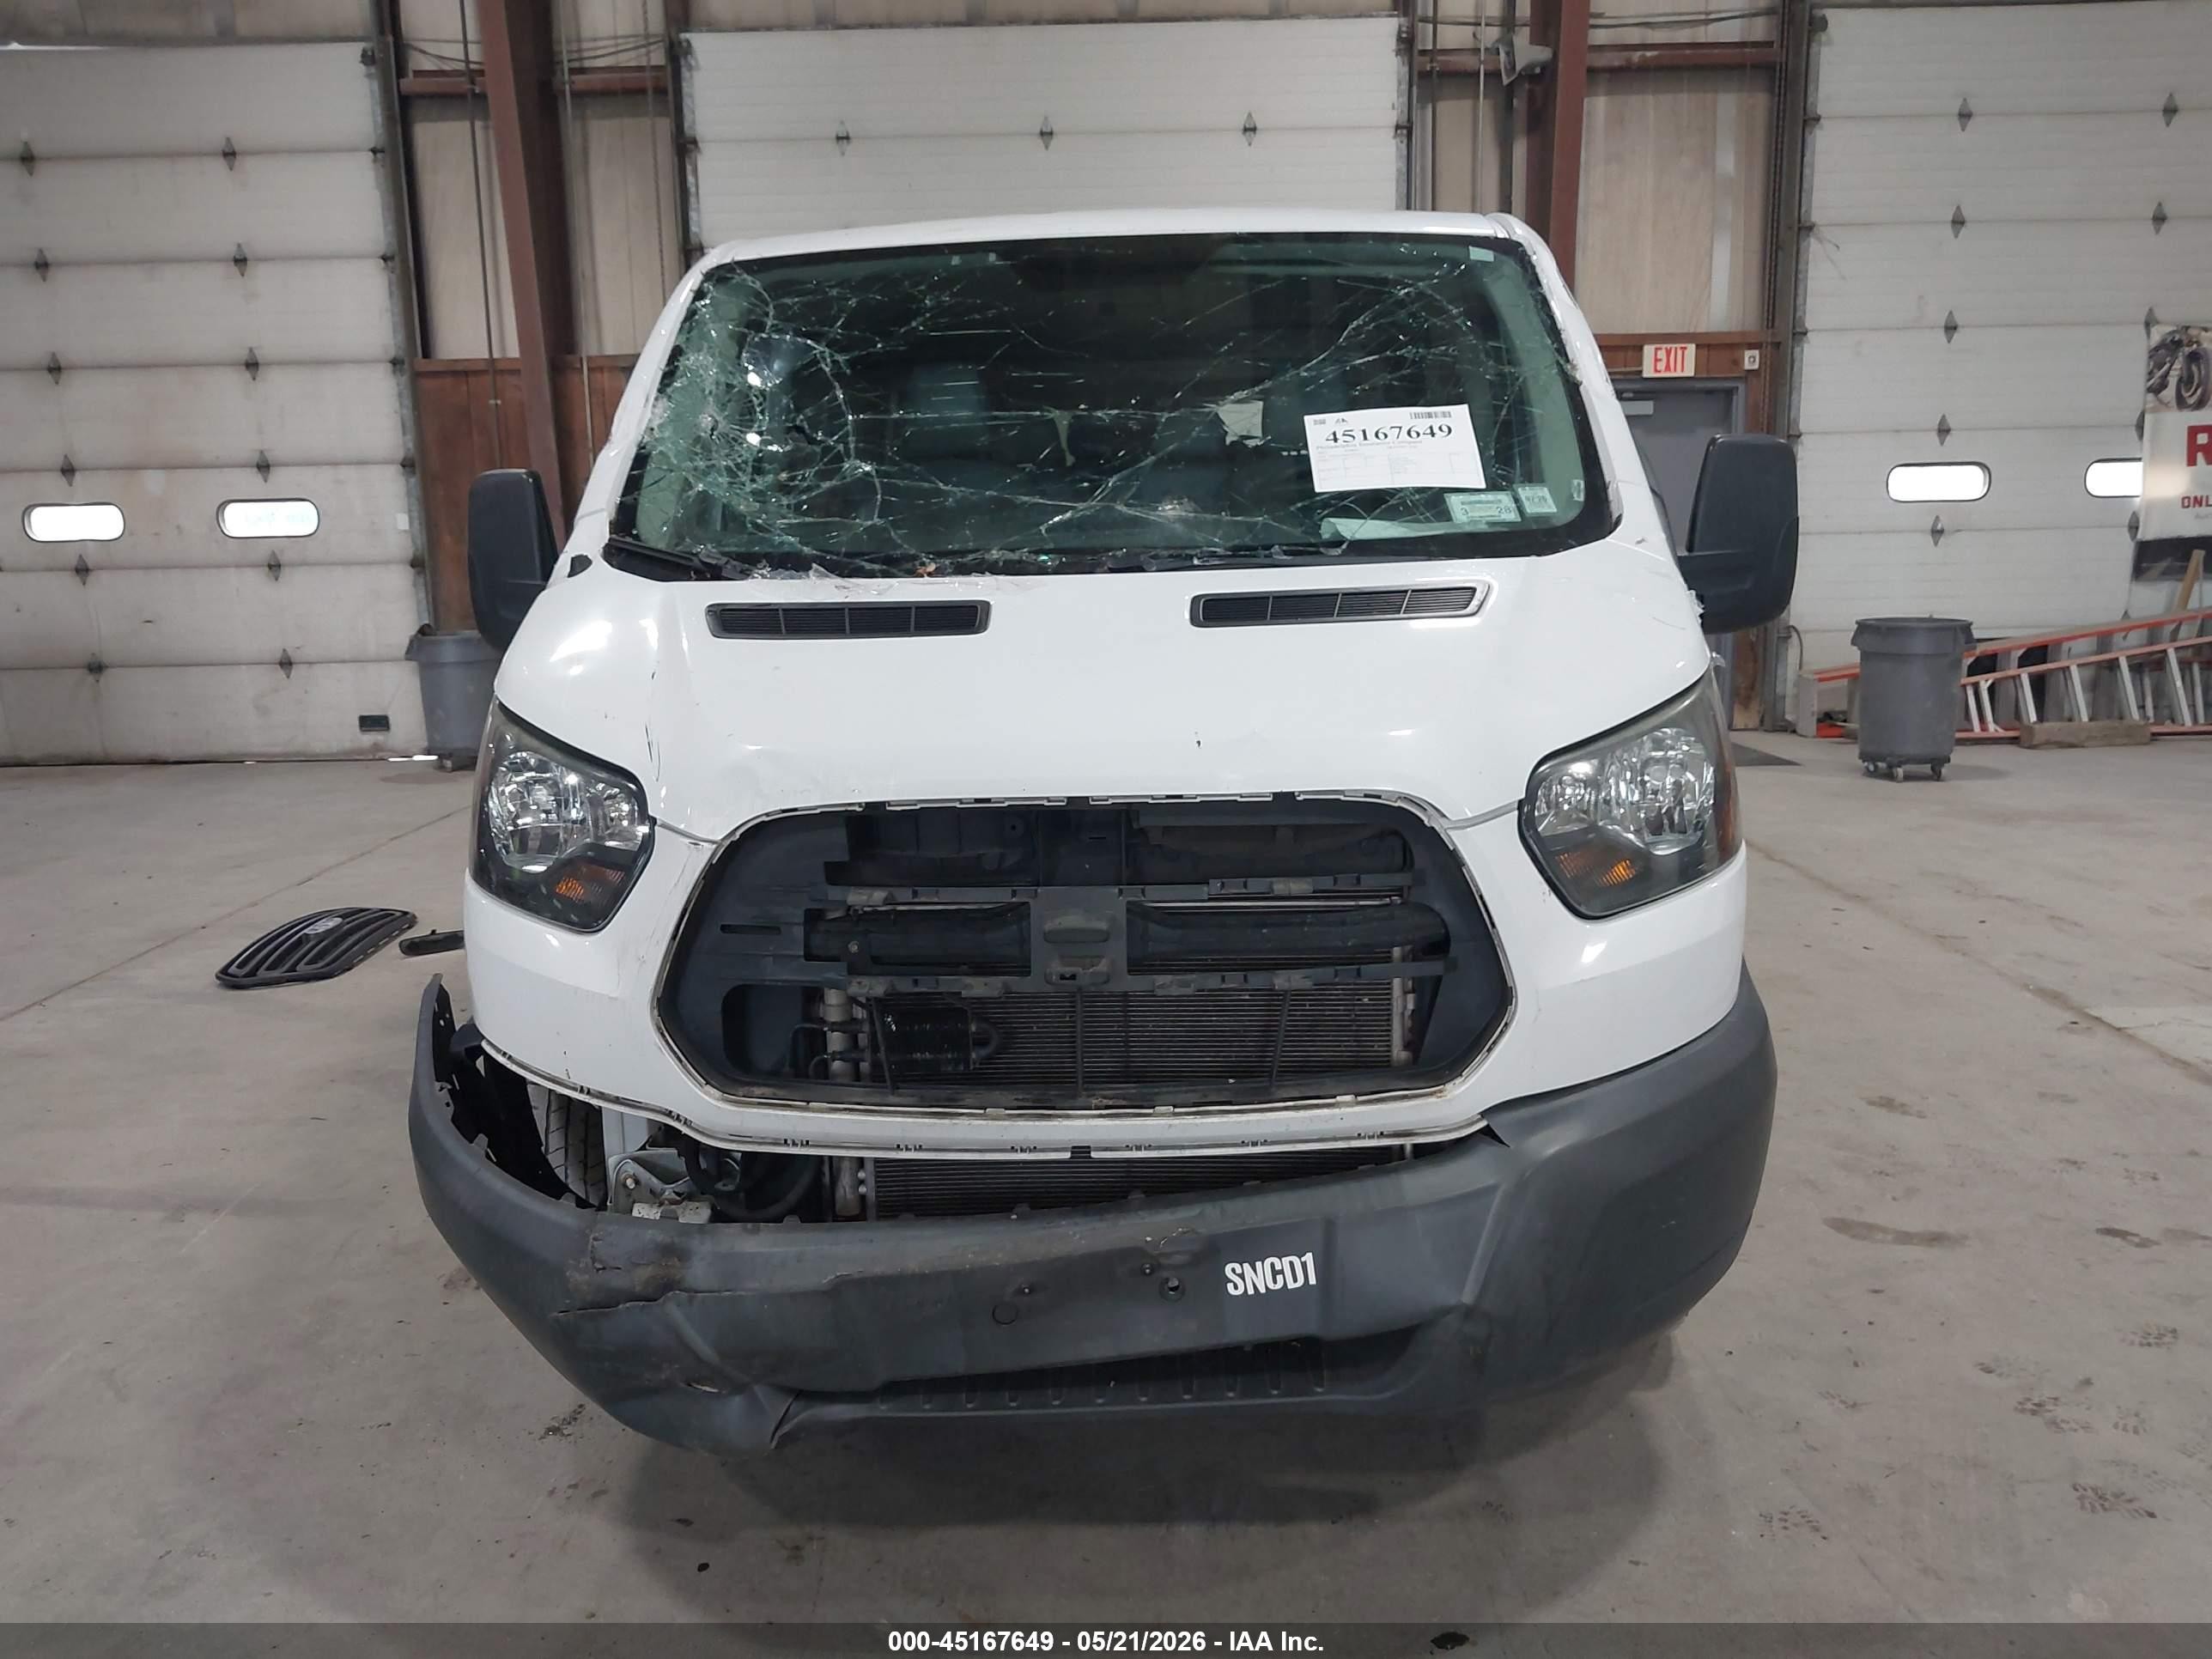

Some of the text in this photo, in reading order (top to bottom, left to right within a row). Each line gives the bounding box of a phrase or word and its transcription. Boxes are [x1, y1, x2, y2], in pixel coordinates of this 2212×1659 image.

[1653, 346, 1687, 374] EXIT
[1325, 423, 1453, 443] 45167649
[1224, 1252, 1316, 1296] SNCD1
